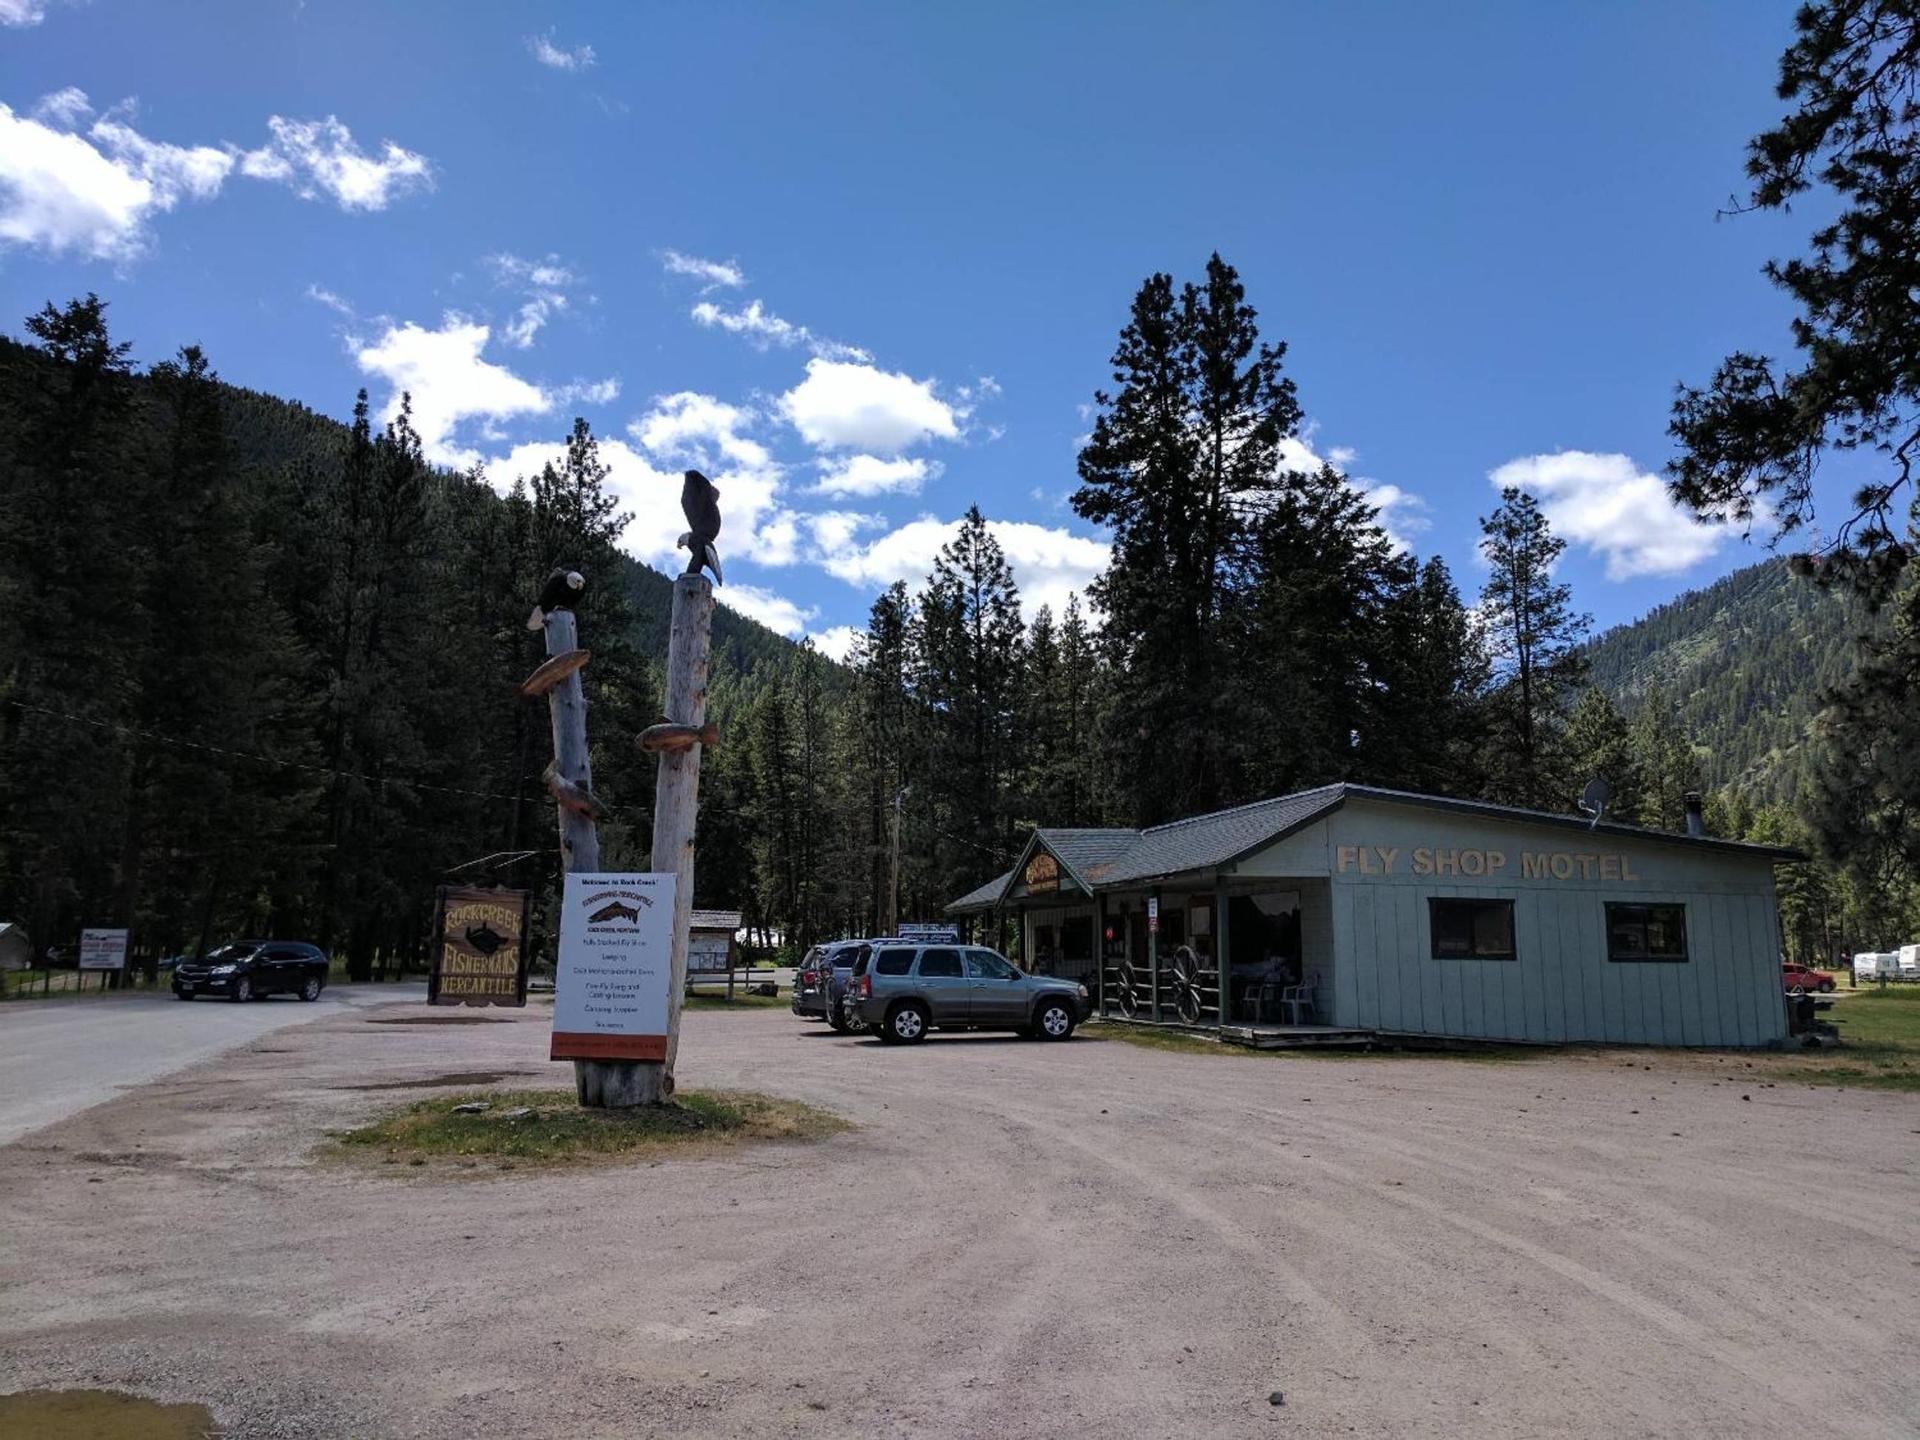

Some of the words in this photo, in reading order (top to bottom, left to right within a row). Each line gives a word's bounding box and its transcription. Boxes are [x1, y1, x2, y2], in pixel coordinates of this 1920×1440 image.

[1336, 845, 1399, 875] FLY
[1411, 847, 1506, 878] SHOP
[1521, 851, 1640, 882] MOTEL
[440, 975, 516, 995] MERCANTILE
